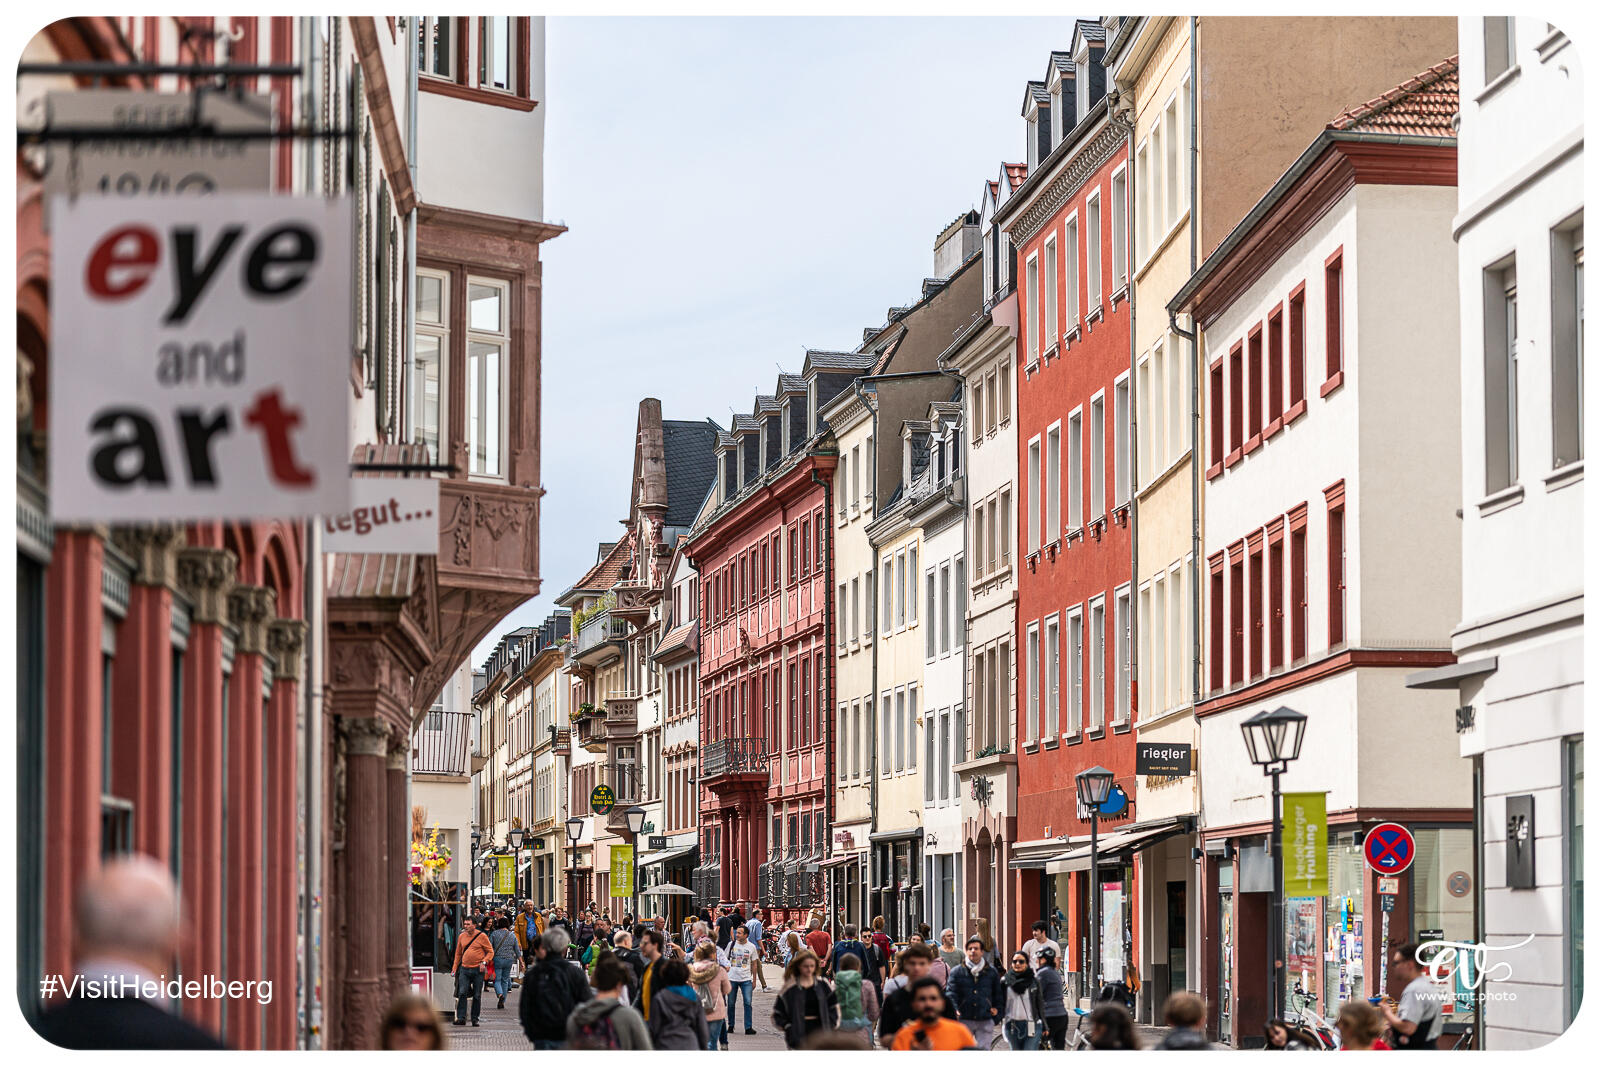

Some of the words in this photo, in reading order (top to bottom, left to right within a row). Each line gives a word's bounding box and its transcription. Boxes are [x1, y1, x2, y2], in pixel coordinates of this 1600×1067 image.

[84, 222, 321, 327] eye
[156, 329, 245, 386] and
[89, 387, 317, 491] art
[1142, 748, 1186, 761] riegler
